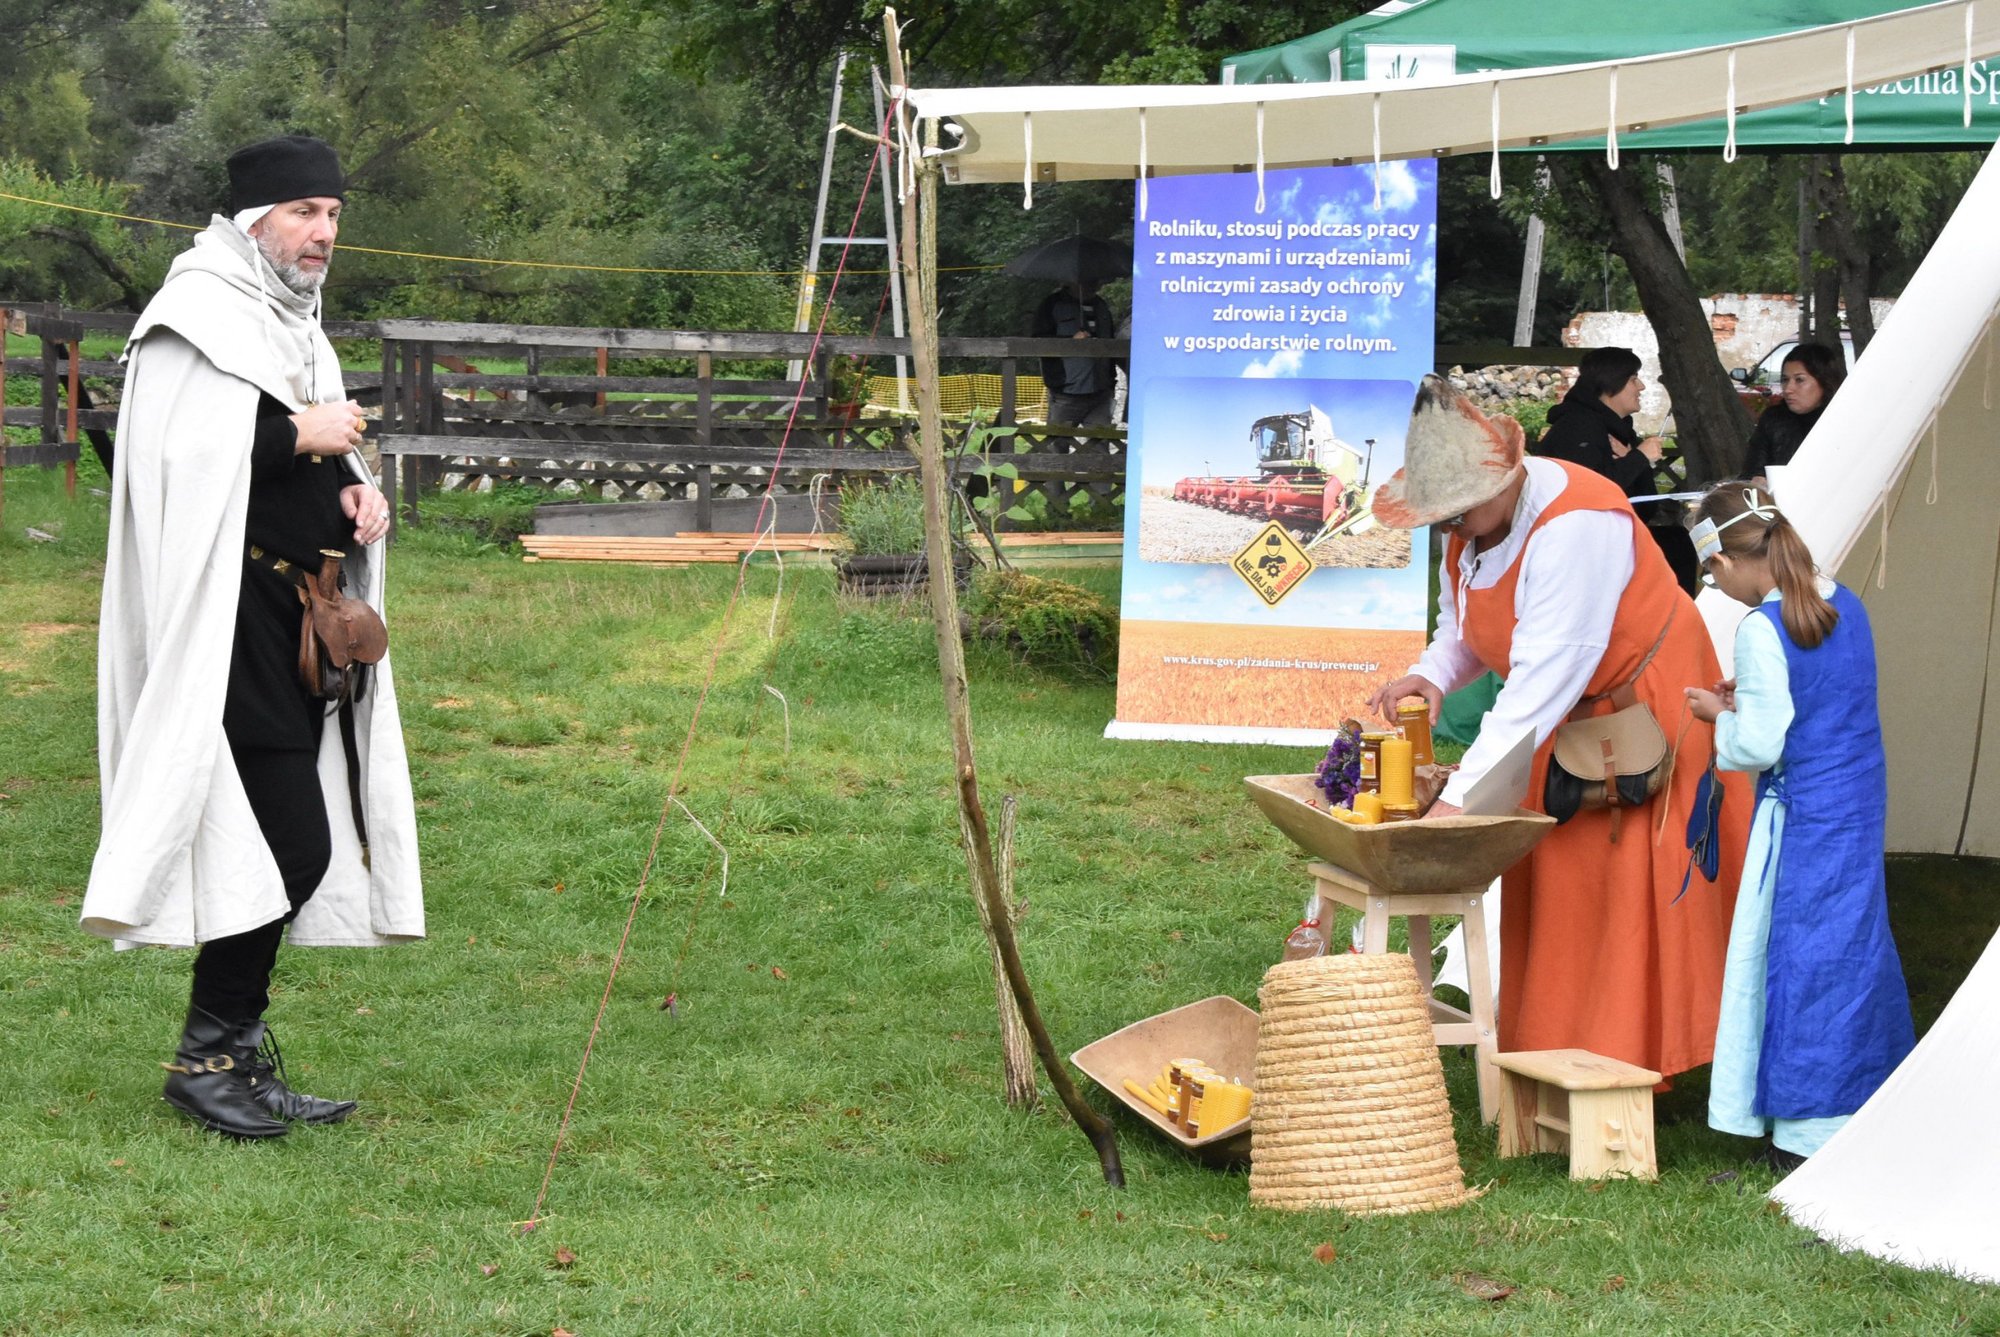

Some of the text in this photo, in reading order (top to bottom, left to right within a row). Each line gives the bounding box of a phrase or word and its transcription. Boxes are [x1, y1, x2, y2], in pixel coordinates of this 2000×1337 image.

[1149, 220, 1420, 240] Rolniku, stosuj podczas pracy
[1155, 248, 1411, 269] z maszynami i urządzeniami
[1160, 276, 1404, 297] rolniczymi zasady ochrony
[1213, 305, 1347, 326] zdrowia i życia
[1164, 333, 1397, 354] w gospodarstwie rolnym.
[1240, 558, 1278, 600] NIE DAJ SIĘ
[1163, 655, 1380, 673] www.krus.gov.pl/zadania-krus/prewencja/
